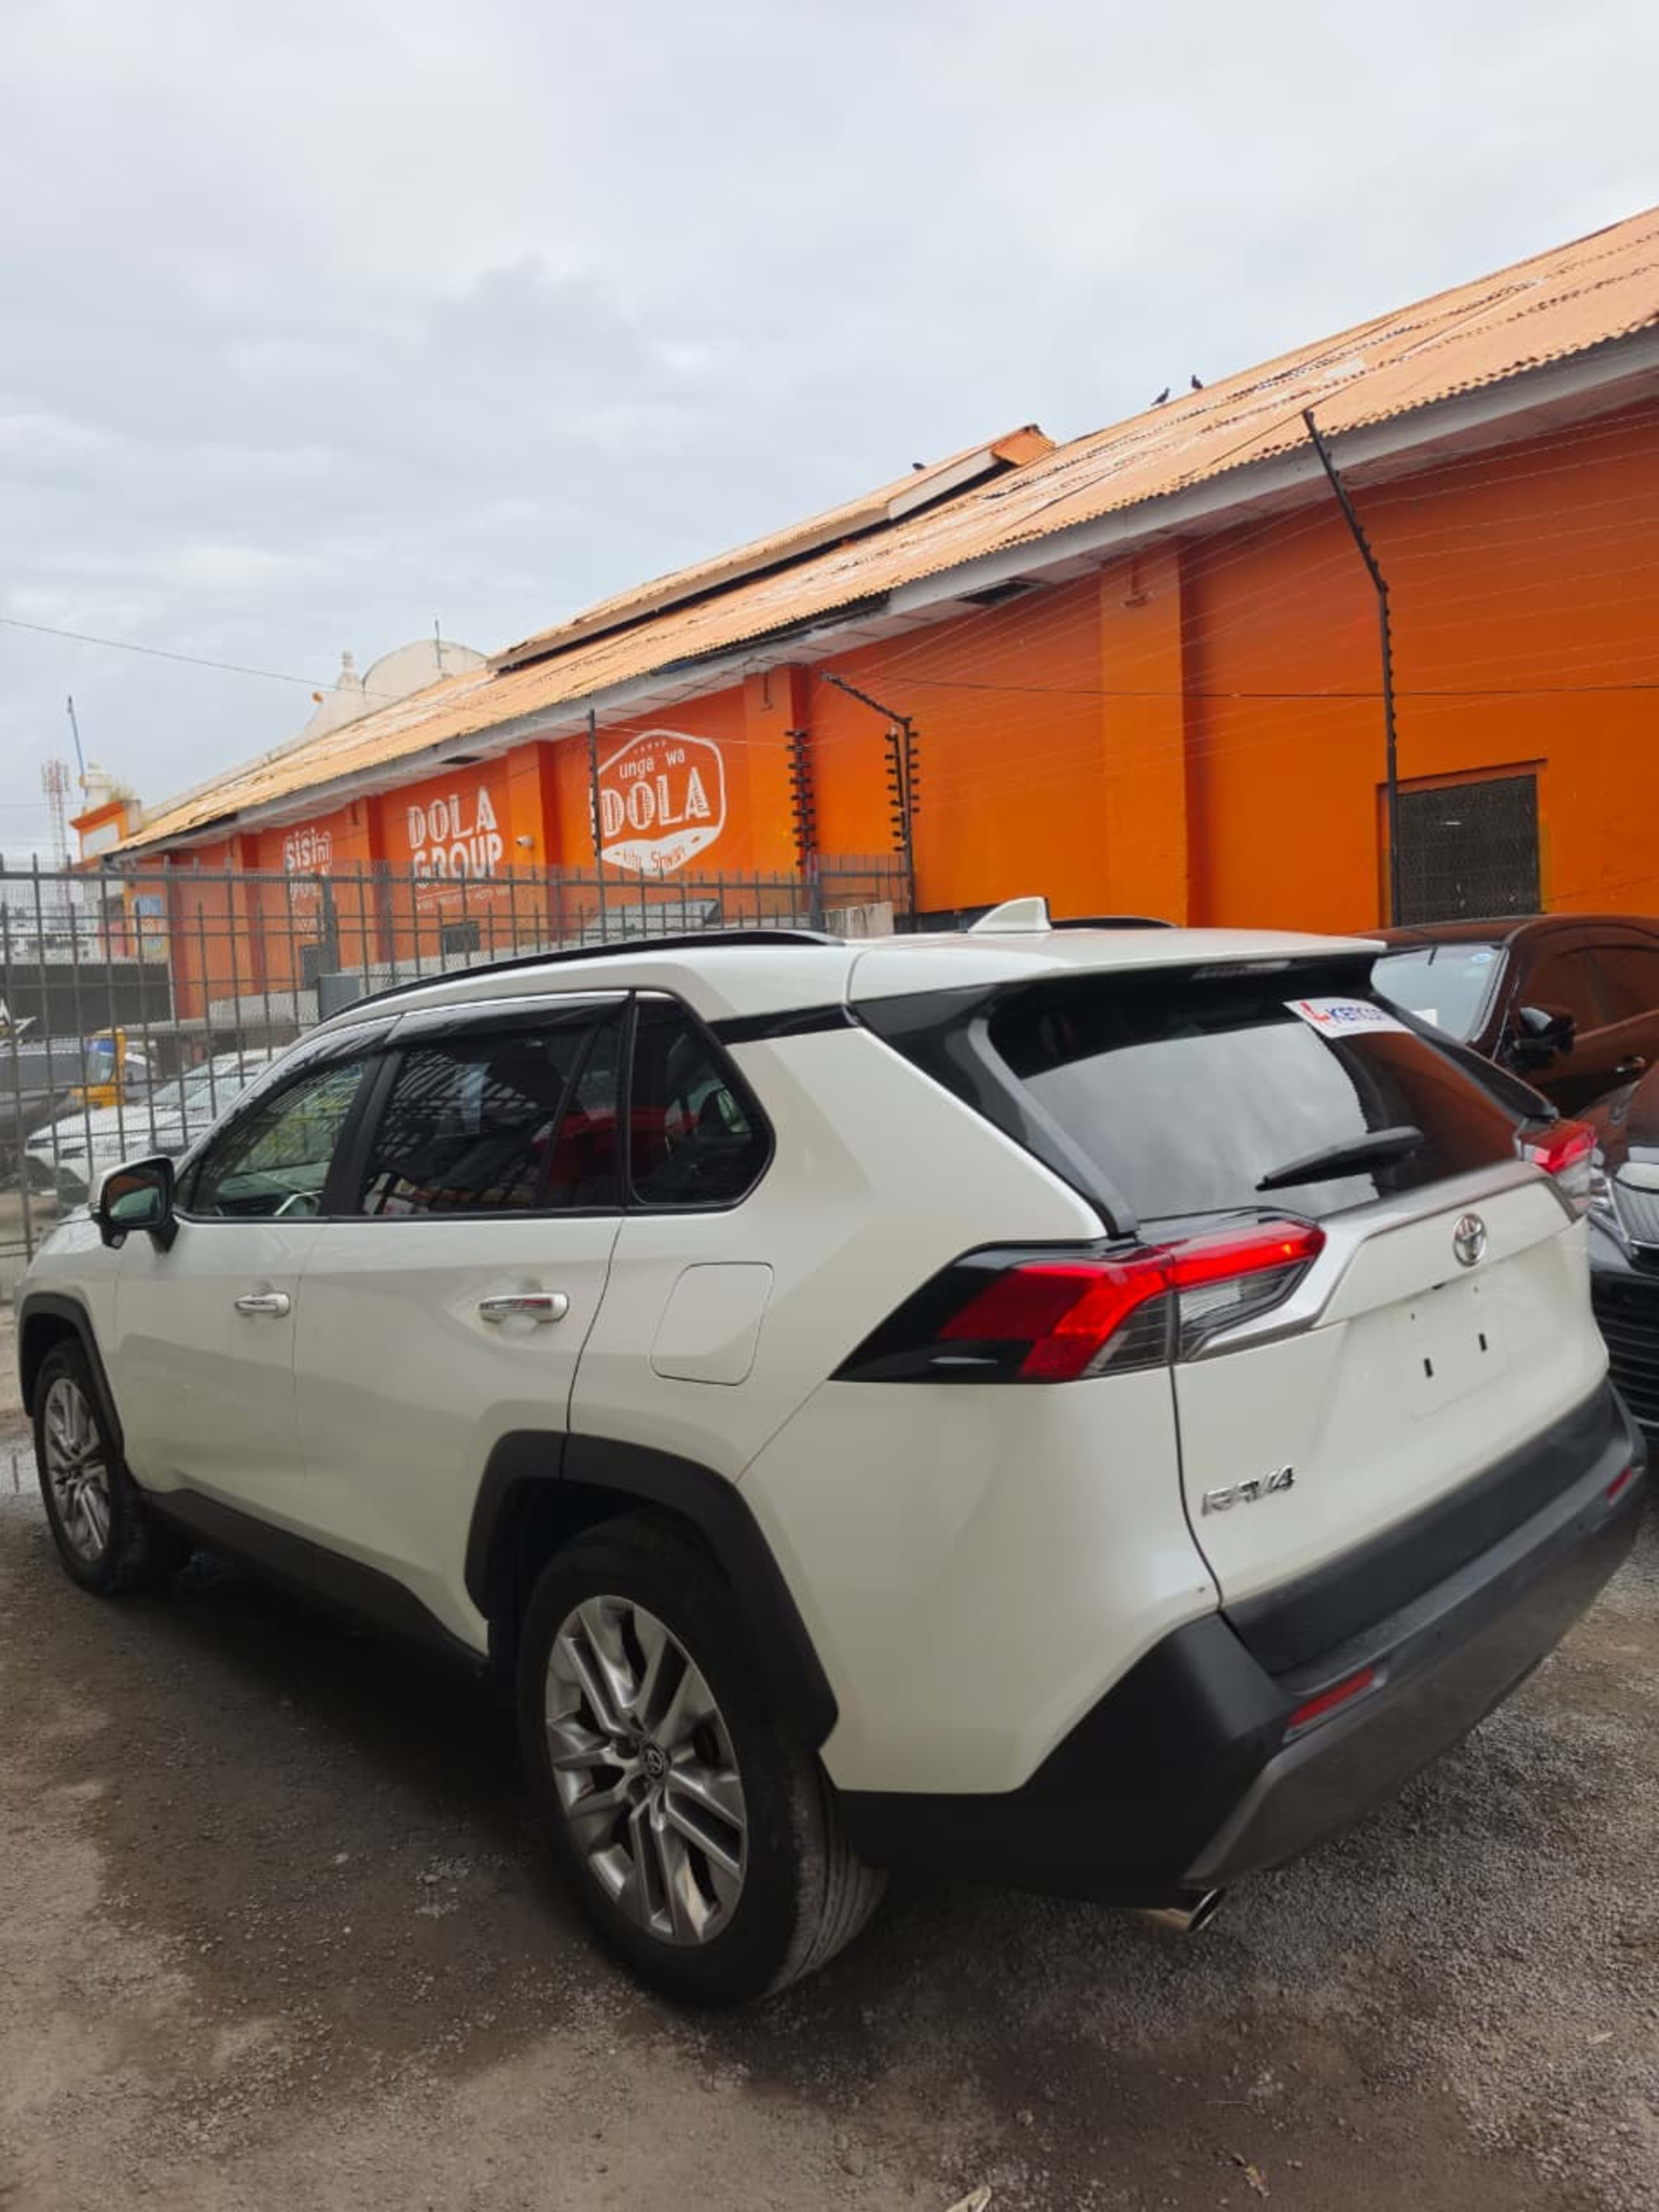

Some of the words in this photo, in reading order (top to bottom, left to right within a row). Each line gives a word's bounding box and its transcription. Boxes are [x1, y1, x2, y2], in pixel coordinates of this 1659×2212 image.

[619, 757, 655, 780] unga
[666, 748, 685, 765] wa
[408, 786, 498, 849] DOLA
[601, 766, 711, 837] DOLA
[413, 833, 503, 888] GROUP
[1202, 1465, 1295, 1516] RAV4
